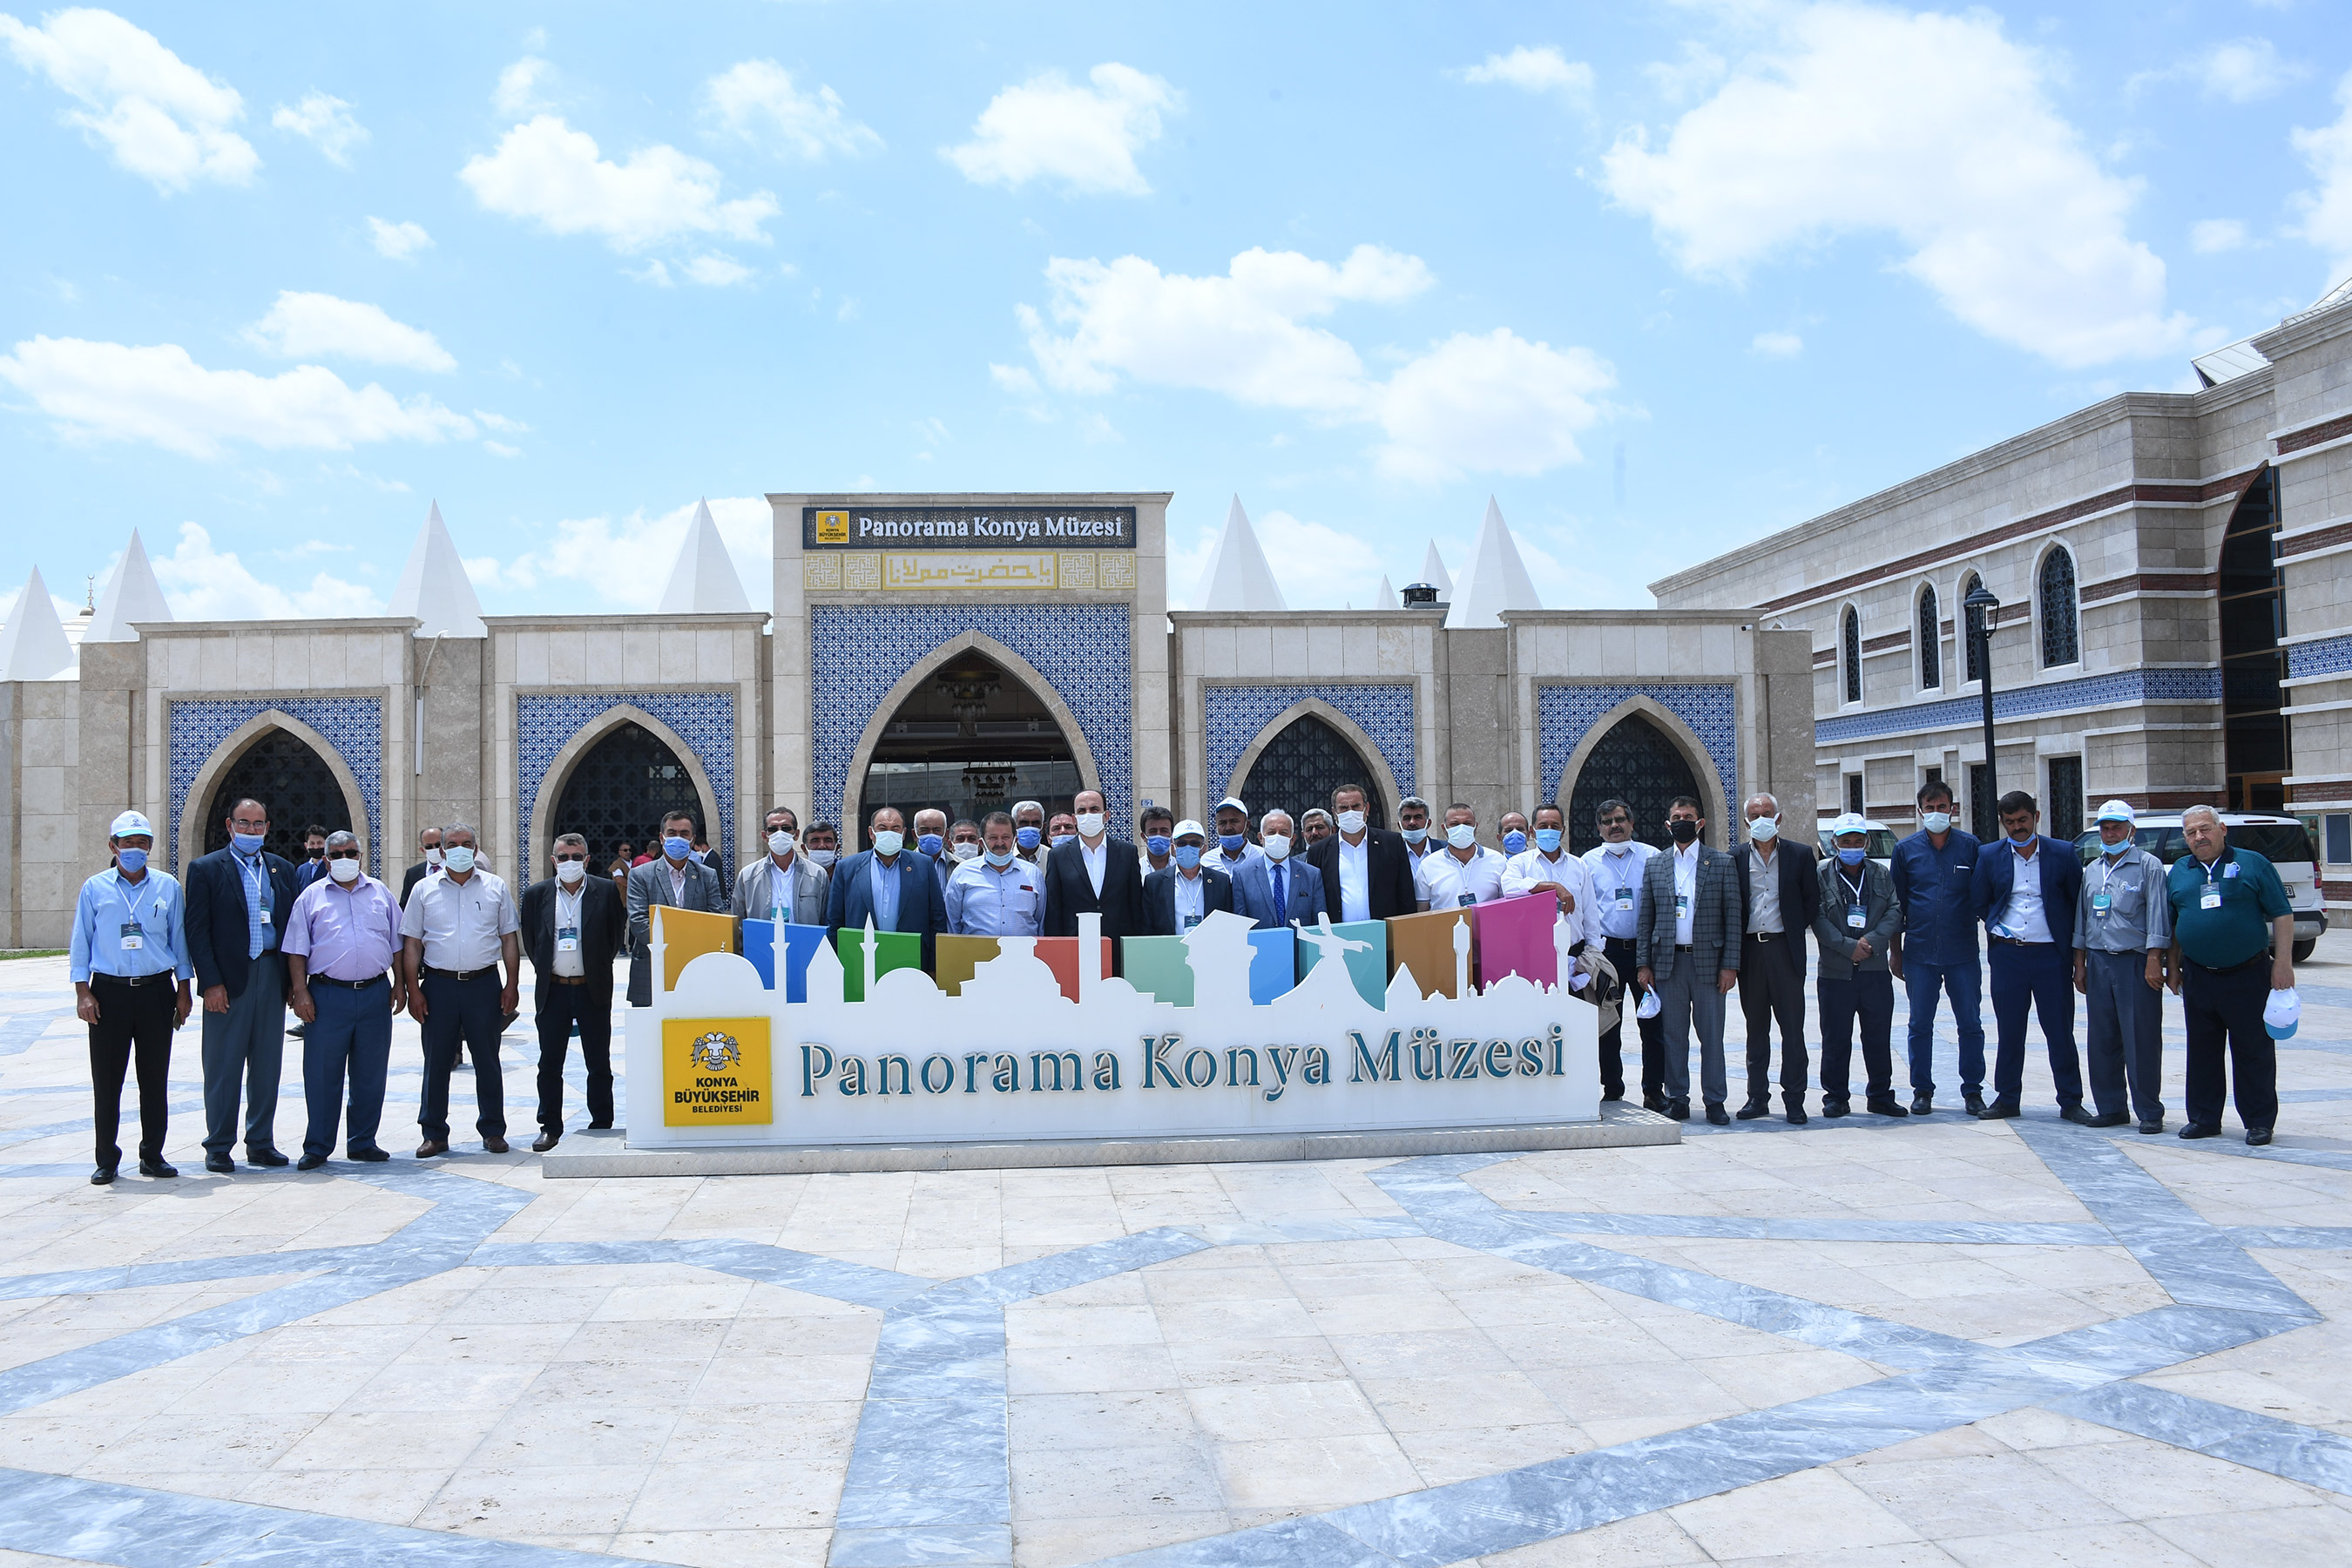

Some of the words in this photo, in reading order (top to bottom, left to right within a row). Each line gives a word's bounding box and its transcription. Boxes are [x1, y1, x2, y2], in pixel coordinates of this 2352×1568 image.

[858, 517, 969, 537] Panorama
[973, 517, 1040, 542] Konya
[1044, 517, 1123, 537] Müzesi
[801, 1043, 1123, 1098] Panorama
[1141, 1037, 1333, 1103] Konya
[1348, 1024, 1565, 1084] Müzesi
[696, 1077, 739, 1088] KONYA
[674, 1087, 760, 1105] BÜYÜKŞEHİR
[692, 1103, 742, 1113] BELEDİYESİ
